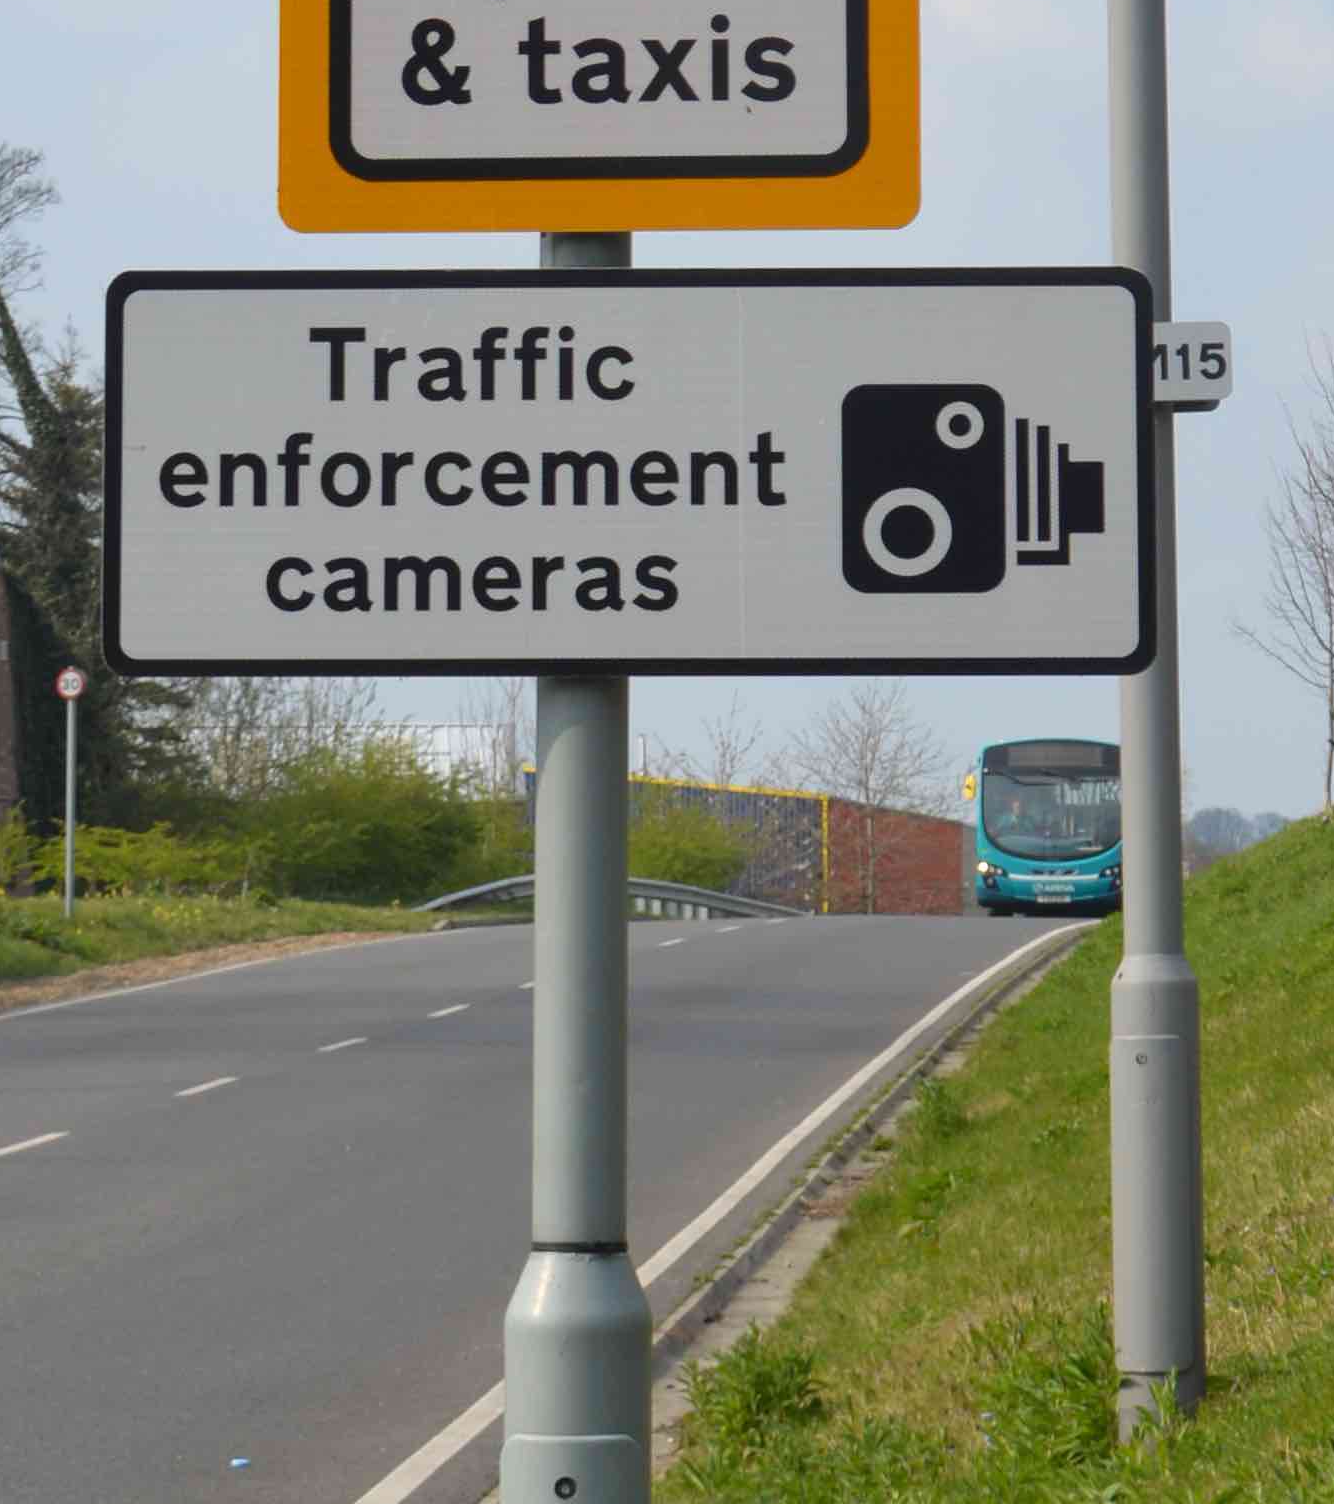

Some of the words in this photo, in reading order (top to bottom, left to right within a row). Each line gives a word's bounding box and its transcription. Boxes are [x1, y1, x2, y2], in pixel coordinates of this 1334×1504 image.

[401, 18, 472, 105] &
[517, 14, 796, 105] taxis
[310, 325, 635, 402] Traffic
[159, 431, 786, 508] enforcement
[266, 554, 679, 613] cameras
[63, 678, 79, 690] 30
